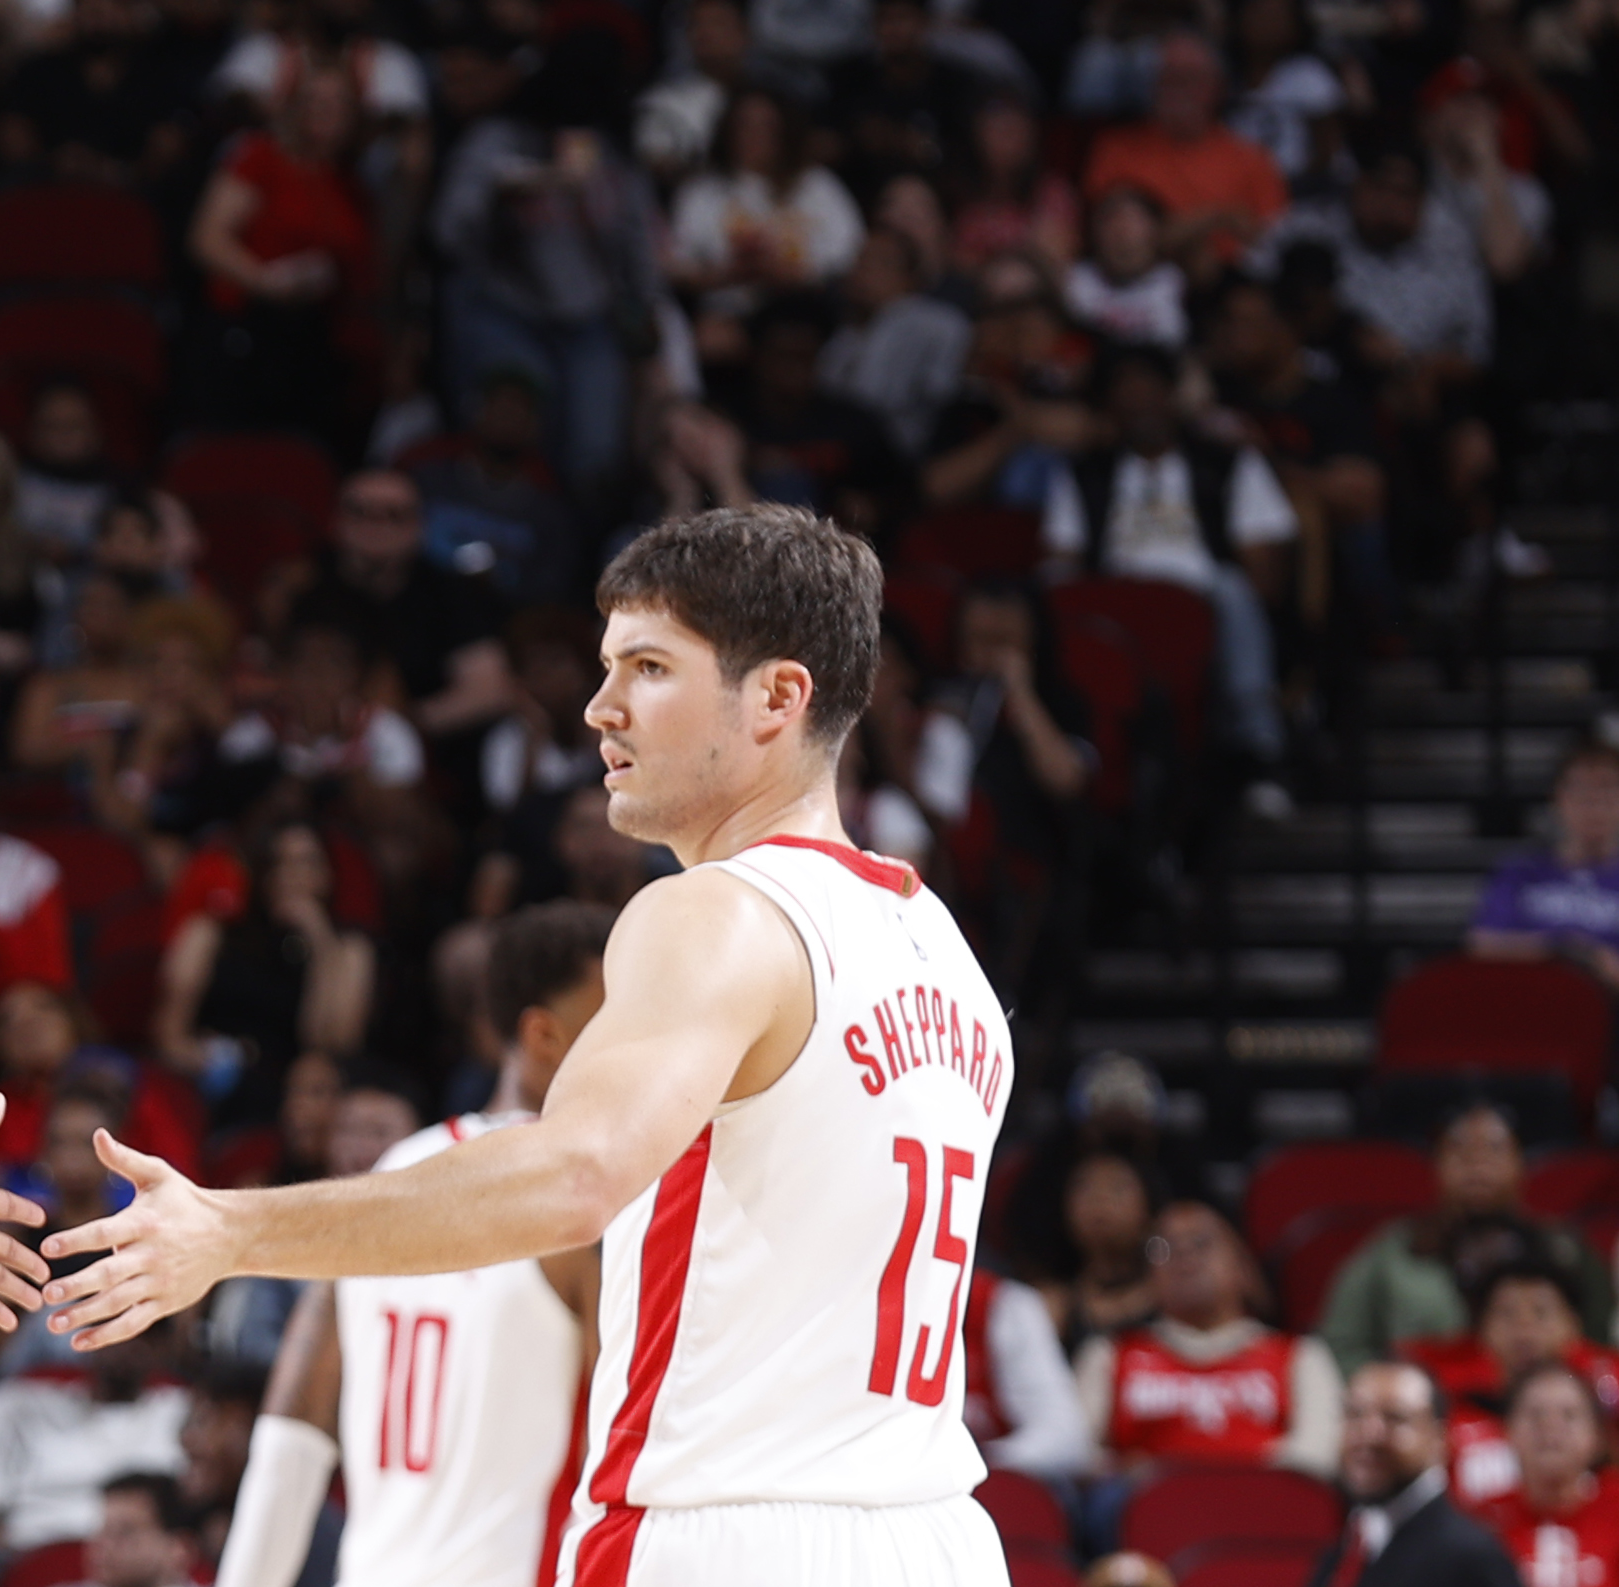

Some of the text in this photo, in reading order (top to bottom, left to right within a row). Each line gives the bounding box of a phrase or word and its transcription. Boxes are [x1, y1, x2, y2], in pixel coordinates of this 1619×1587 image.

[843, 983, 1003, 1118] SHEPPARD
[867, 1134, 975, 1408] 15
[377, 1304, 449, 1474] 10
